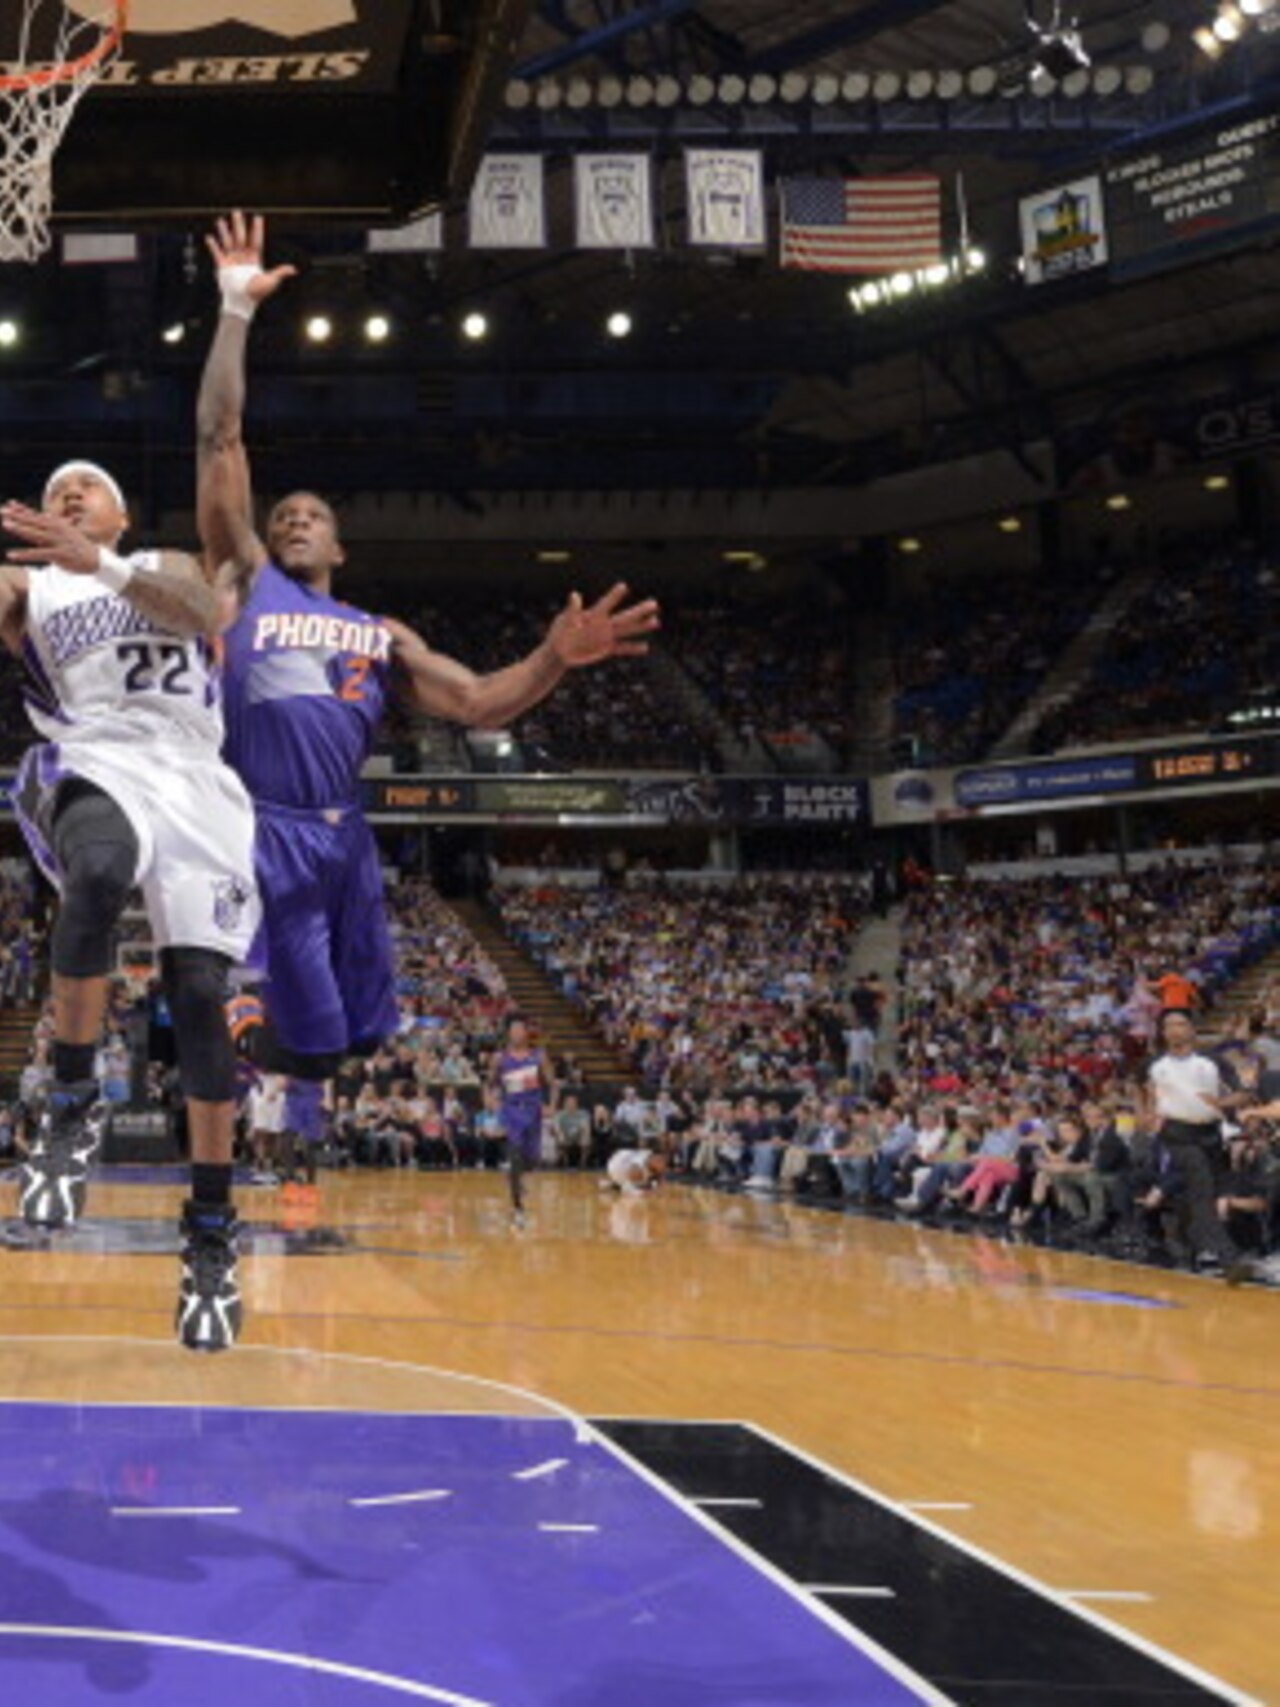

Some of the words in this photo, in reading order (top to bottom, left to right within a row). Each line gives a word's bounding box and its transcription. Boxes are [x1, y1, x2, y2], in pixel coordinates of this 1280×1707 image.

[151, 50, 370, 85] SLEEP
[253, 614, 392, 662] PHOENIX
[117, 641, 193, 695] 22
[339, 657, 374, 701] 2
